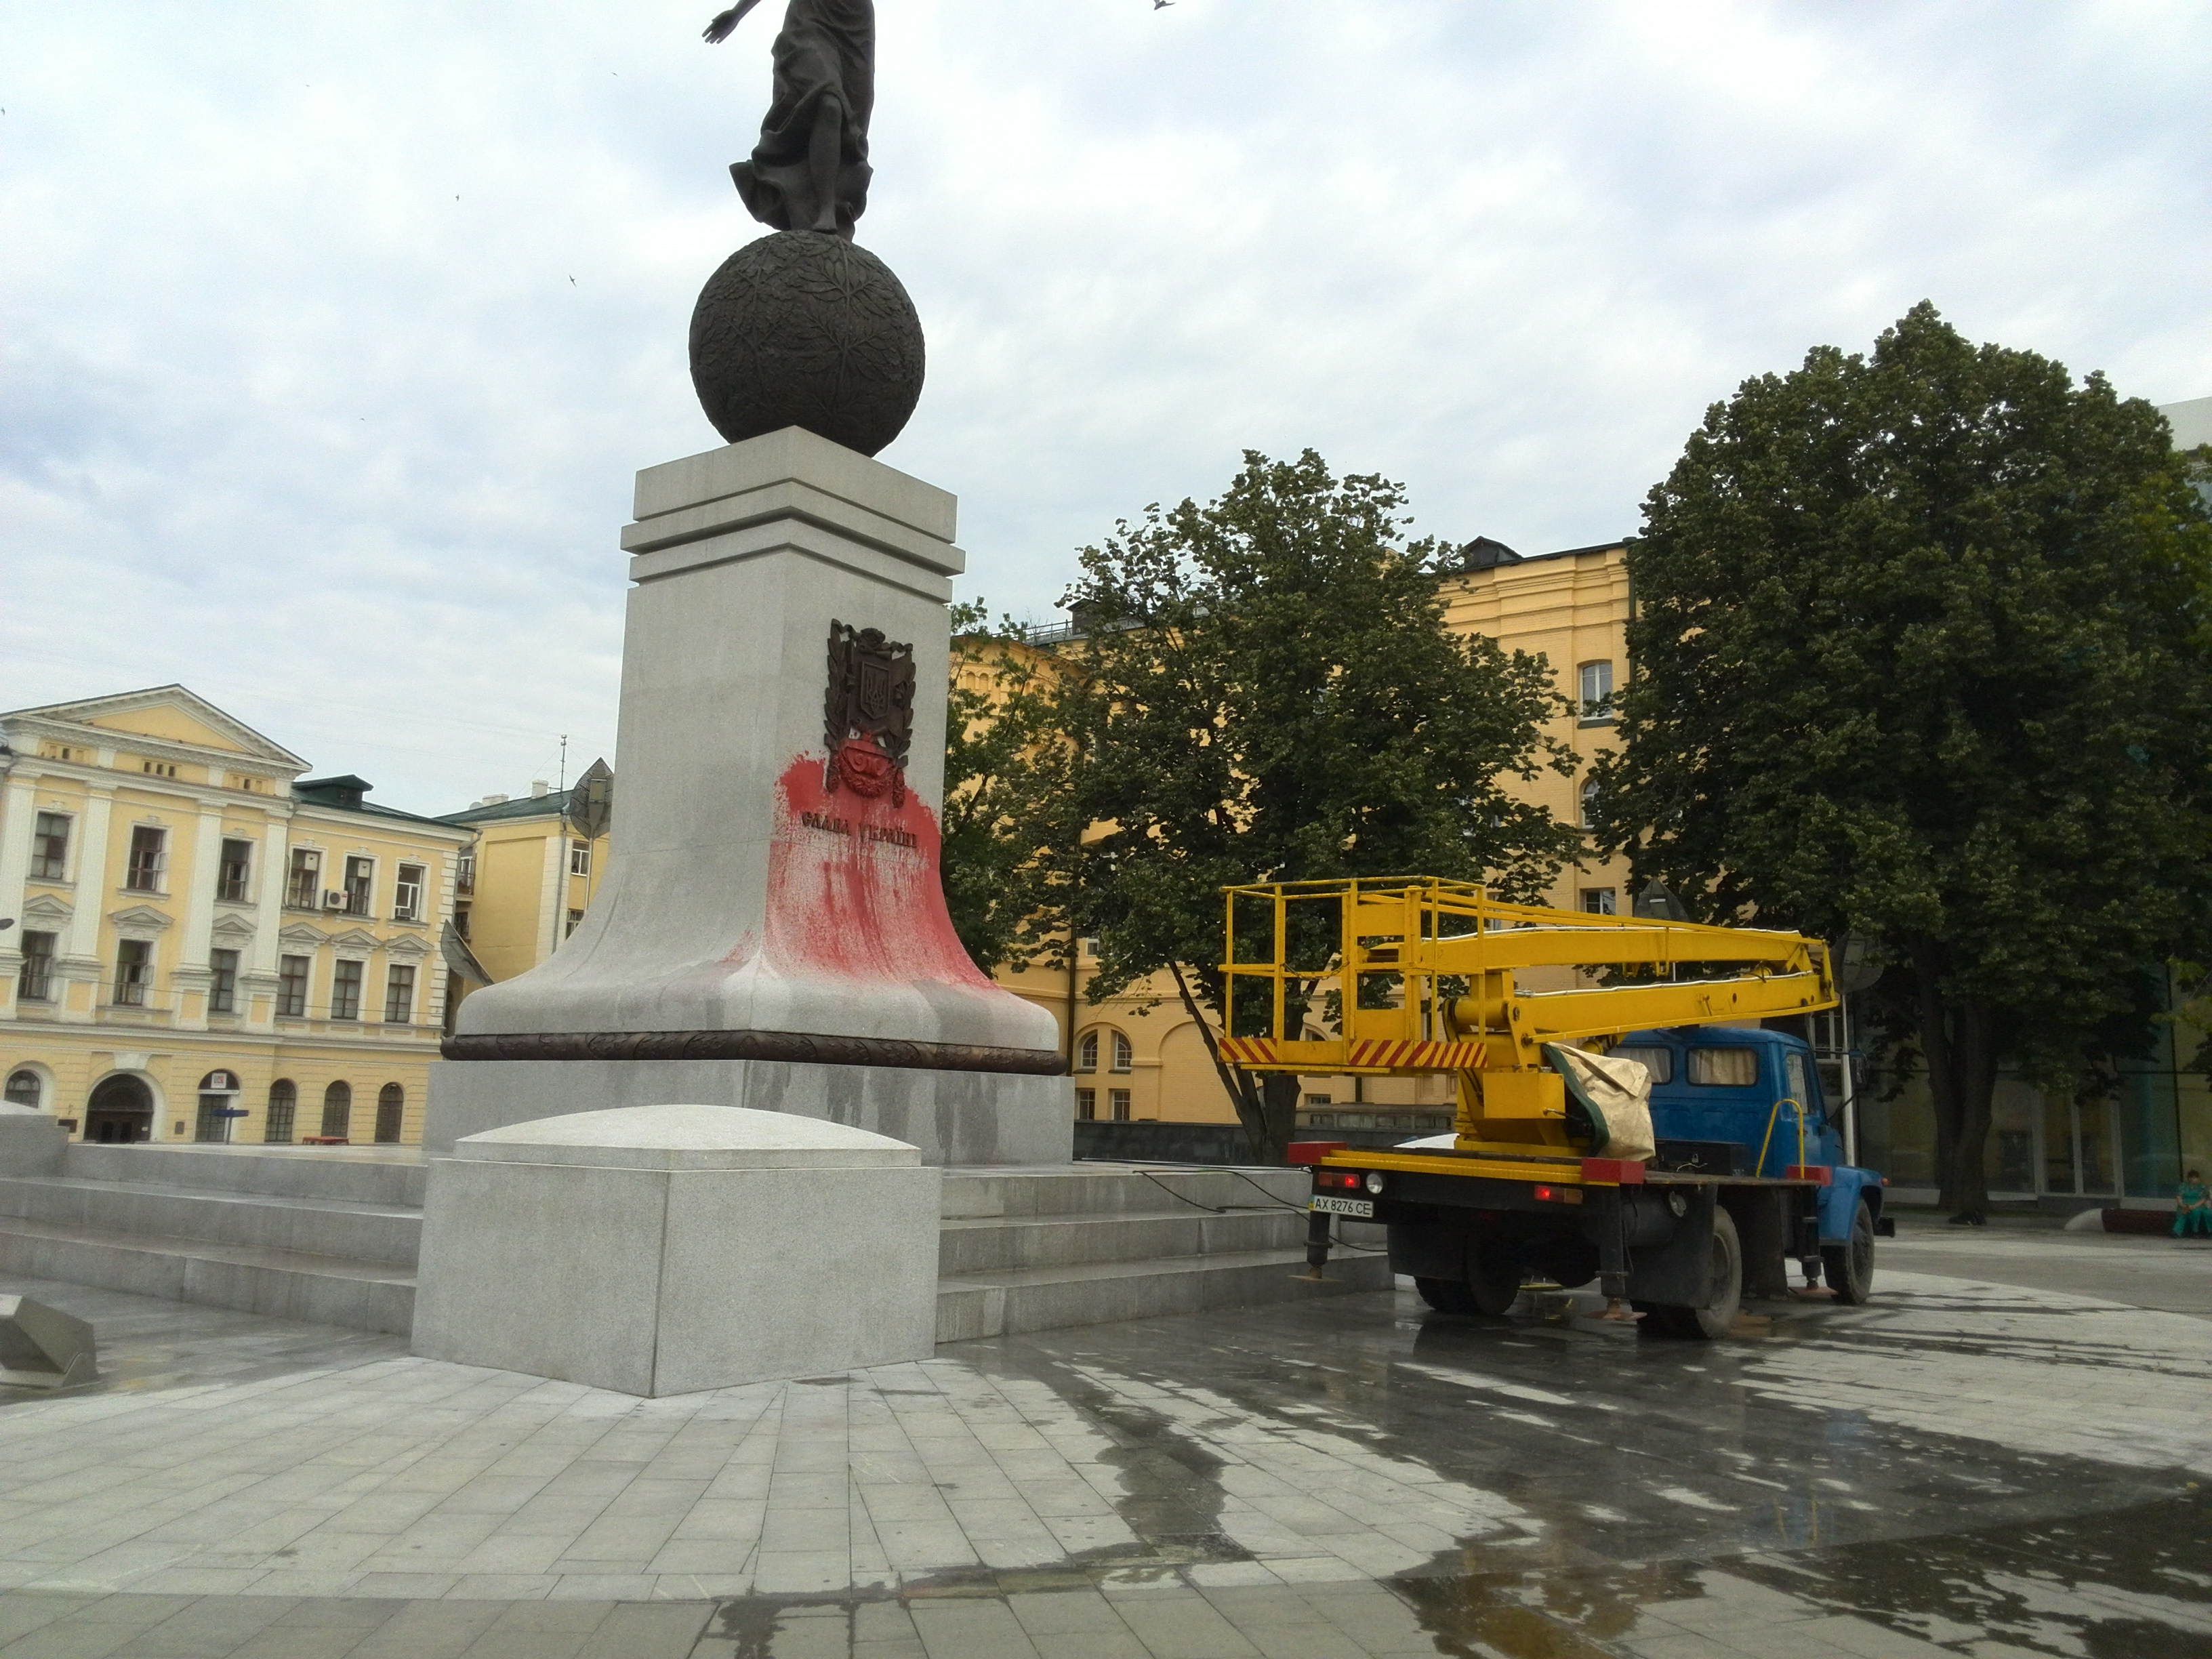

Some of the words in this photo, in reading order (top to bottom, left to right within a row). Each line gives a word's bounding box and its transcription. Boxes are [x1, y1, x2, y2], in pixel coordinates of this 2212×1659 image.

[1315, 1198, 1328, 1210] AX
[1331, 1200, 1353, 1212] 8276
[1356, 1202, 1372, 1215] CE
